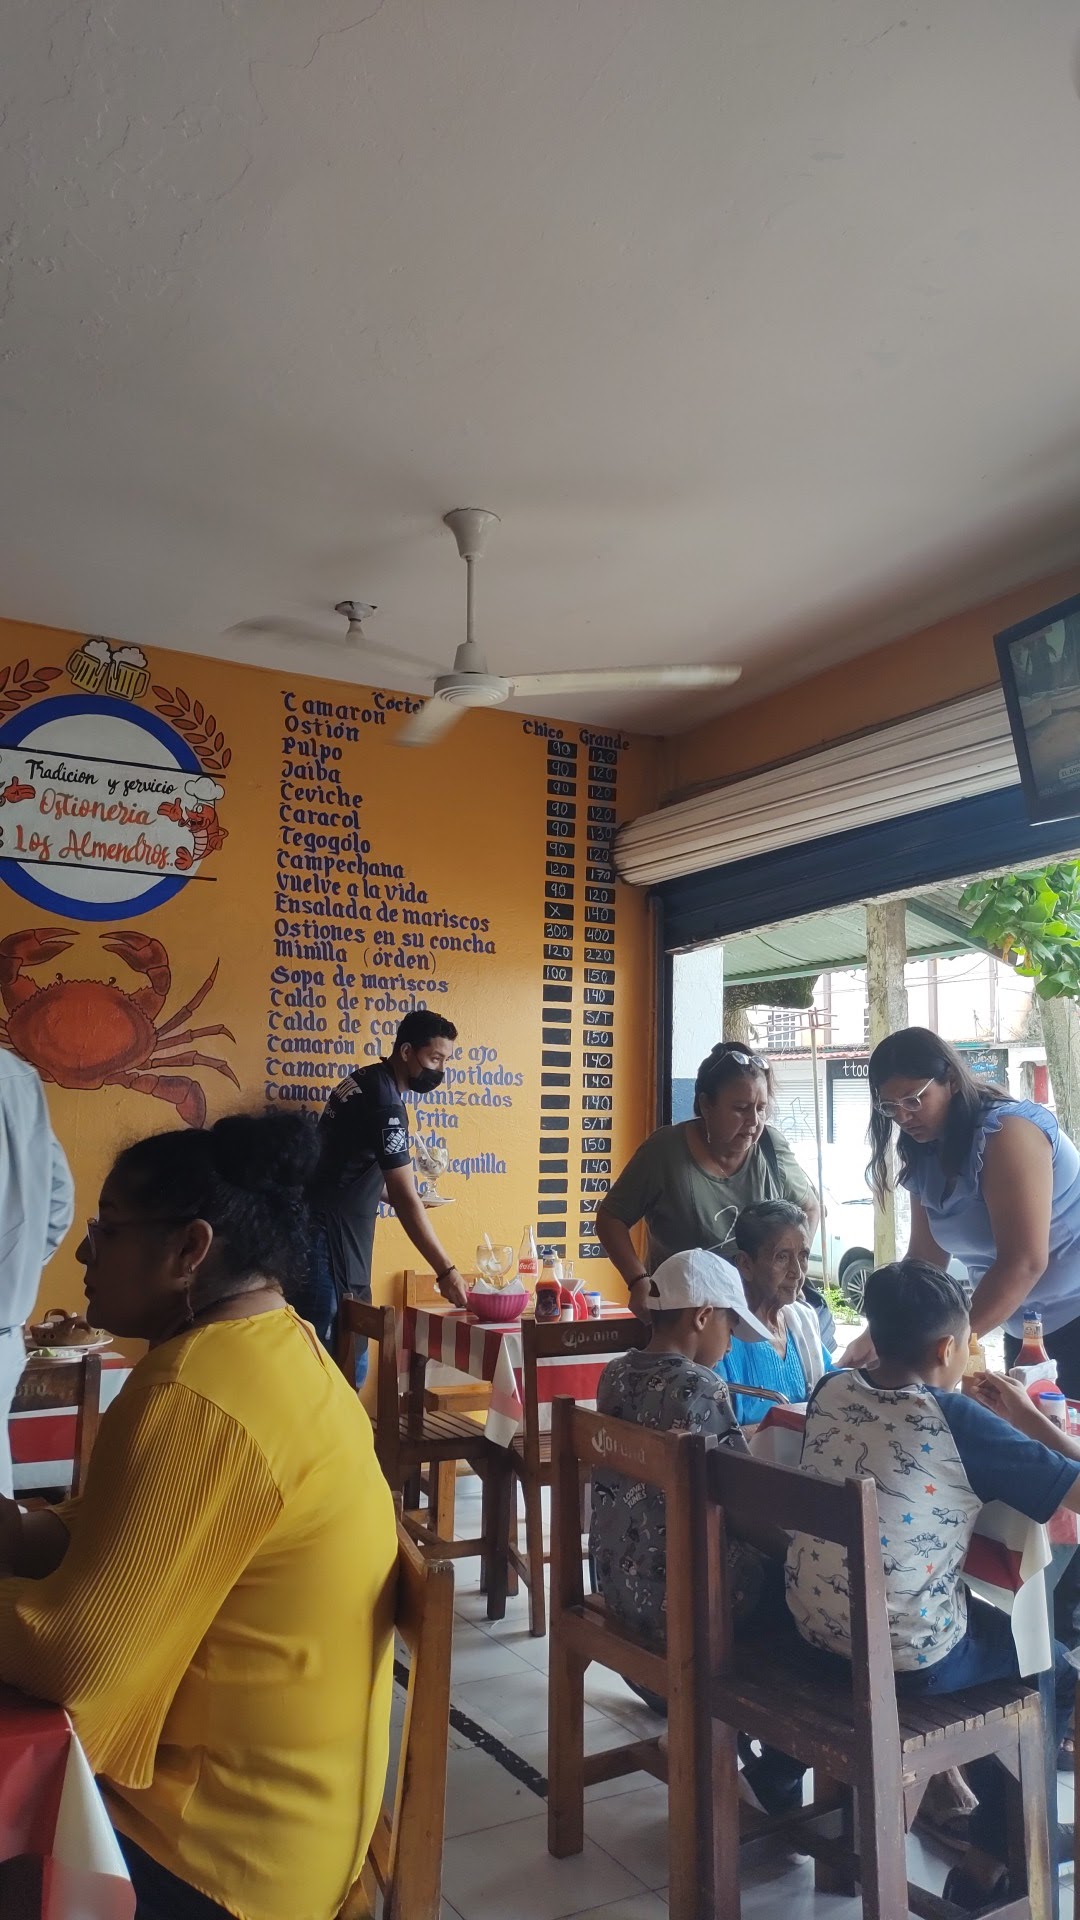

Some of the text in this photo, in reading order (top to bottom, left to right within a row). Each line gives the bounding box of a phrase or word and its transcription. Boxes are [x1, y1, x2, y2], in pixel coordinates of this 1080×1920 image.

[281, 690, 386, 724] Camaron
[521, 719, 630, 751] Chico Grande
[281, 736, 343, 764] Pulpo
[552, 740, 571, 755] 90
[592, 750, 615, 763] 120
[552, 761, 570, 777] 90
[593, 767, 613, 780] 120
[107, 776, 120, 793] y
[123, 777, 177, 797] servicio
[280, 780, 364, 808] Ceviche
[552, 782, 569, 795] 90
[591, 786, 611, 798] 120
[279, 802, 361, 829] Caracol
[551, 802, 568, 816] 90
[591, 806, 611, 820] 120
[551, 821, 569, 836] 90
[591, 827, 612, 841] 130
[15, 825, 53, 861] Los
[549, 843, 567, 856] 90
[589, 848, 609, 861] 120
[276, 848, 405, 879] Campechana
[550, 863, 568, 875] 120
[591, 868, 611, 880] 170
[347, 882, 359, 897] a
[362, 877, 382, 899] la
[384, 882, 429, 904] vida
[550, 882, 567, 897] 90
[589, 889, 608, 903] 120
[274, 891, 490, 933] Ensalada de mariscos
[587, 906, 609, 921] 140
[274, 918, 497, 954] Ostiones en su concha
[546, 923, 568, 938] 300
[587, 928, 610, 942] 400
[273, 938, 347, 963] Minilla
[548, 944, 570, 958] 120
[585, 949, 611, 962] 220
[270, 964, 449, 993] Sopa de mariscos
[546, 966, 567, 980] 100
[587, 969, 608, 984] 150
[270, 987, 428, 1013] Caldo de robalo
[586, 988, 606, 1003] 140
[267, 1009, 328, 1032] Caldo
[337, 1011, 362, 1033] de
[585, 1010, 611, 1024] S/T
[586, 1031, 609, 1044] 150
[363, 1037, 382, 1057] al
[584, 1053, 611, 1068] 140
[584, 1074, 610, 1088] 140
[585, 1095, 610, 1111] 140
[583, 1117, 610, 1130] S/T
[584, 1138, 606, 1151] 150
[585, 1159, 609, 1173] 140
[583, 1178, 608, 1192] 140
